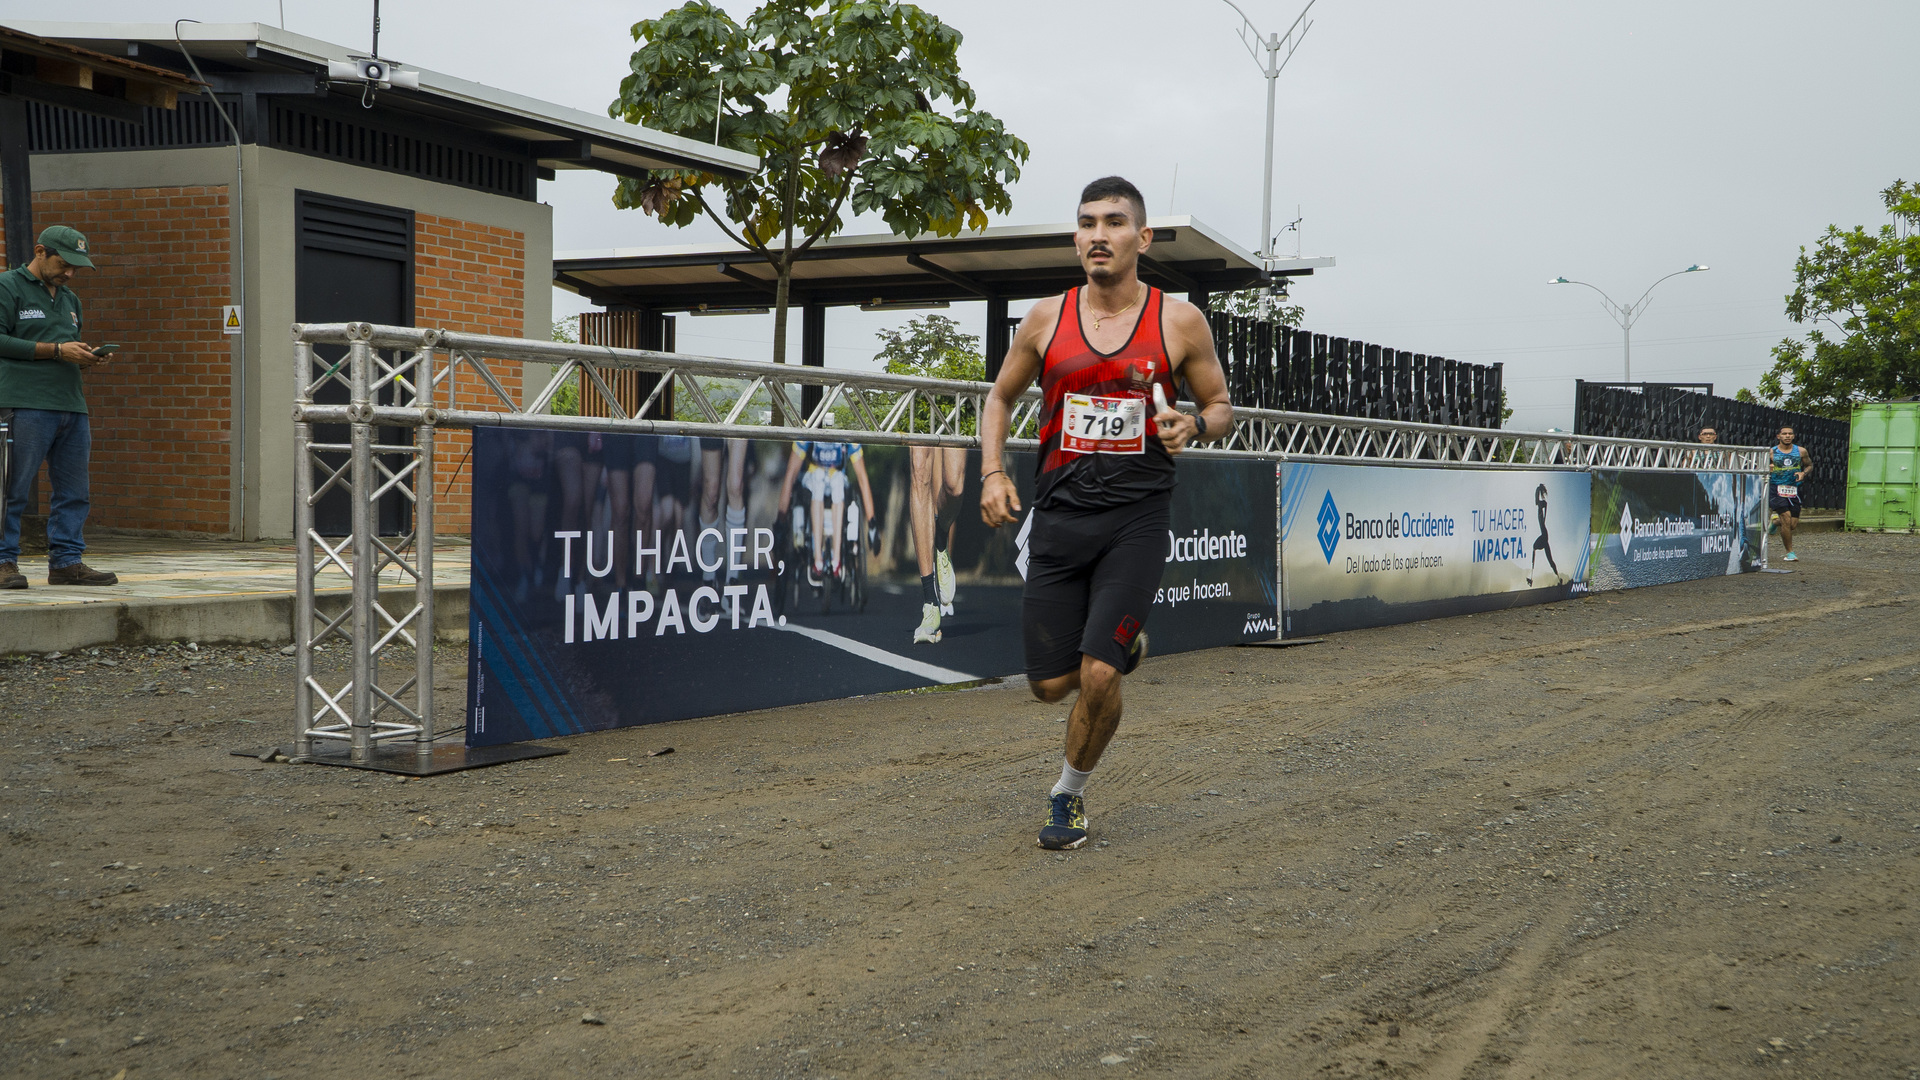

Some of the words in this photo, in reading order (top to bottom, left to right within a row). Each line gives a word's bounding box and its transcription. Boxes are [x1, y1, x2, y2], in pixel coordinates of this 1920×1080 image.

[1083, 414, 1124, 437] 719
[1346, 512, 1383, 540] Banco
[1386, 512, 1399, 538] de
[1402, 512, 1454, 538] Occidente
[1472, 510, 1486, 532] TU
[1489, 508, 1527, 533] HACER,
[1634, 517, 1654, 538] Banco
[1654, 517, 1664, 537] de
[1664, 516, 1695, 537] Occidente
[1701, 514, 1709, 531] TU
[1710, 513, 1732, 532] HACER,
[554, 530, 614, 578] TU
[635, 527, 785, 576] HACER,
[1472, 536, 1527, 563] IMPACTA.
[1701, 535, 1732, 554] IMPACTA.
[1346, 555, 1360, 574] Del
[1362, 554, 1380, 573] lado
[1381, 553, 1391, 571] de
[1393, 552, 1403, 570] los
[1405, 557, 1419, 574] que
[1420, 551, 1444, 569] hacen.
[1167, 585, 1190, 608] que
[1193, 578, 1231, 600] hacen.
[564, 584, 787, 643] IMPACTA.
[1243, 618, 1276, 634] AVAL
